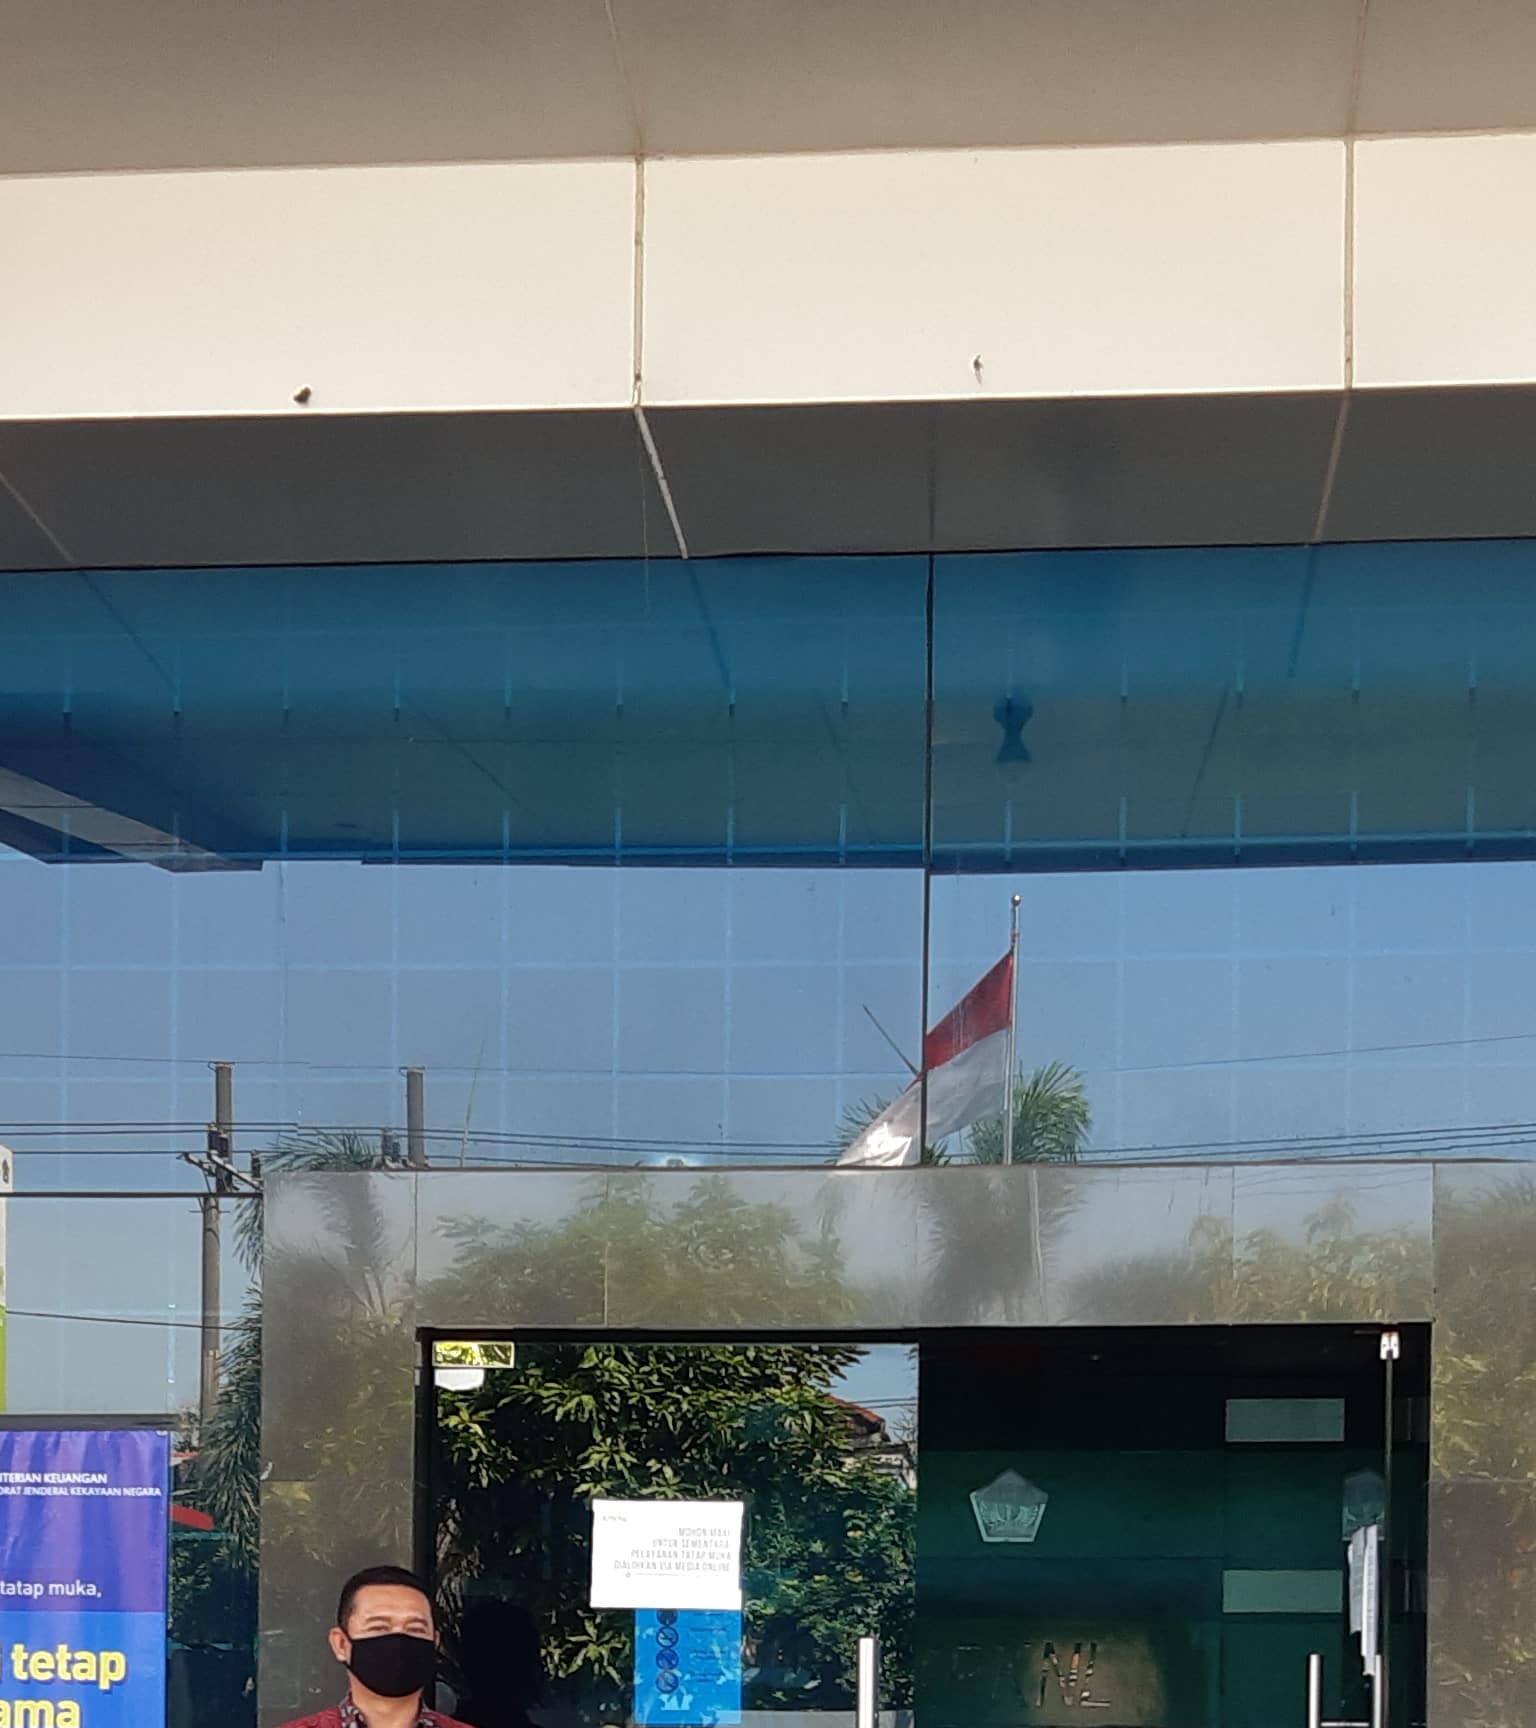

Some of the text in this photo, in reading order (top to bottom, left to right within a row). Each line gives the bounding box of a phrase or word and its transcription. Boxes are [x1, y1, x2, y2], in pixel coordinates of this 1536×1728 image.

[44, 1472, 107, 1484] KEUANGAN
[23, 1486, 69, 1497] JENDERAL
[70, 1486, 122, 1497] KEKAYAAN
[123, 1487, 161, 1497] NEGARA
[0, 1580, 44, 1600] tatap
[48, 1581, 103, 1600] muka,
[11, 1643, 127, 1691] tetap
